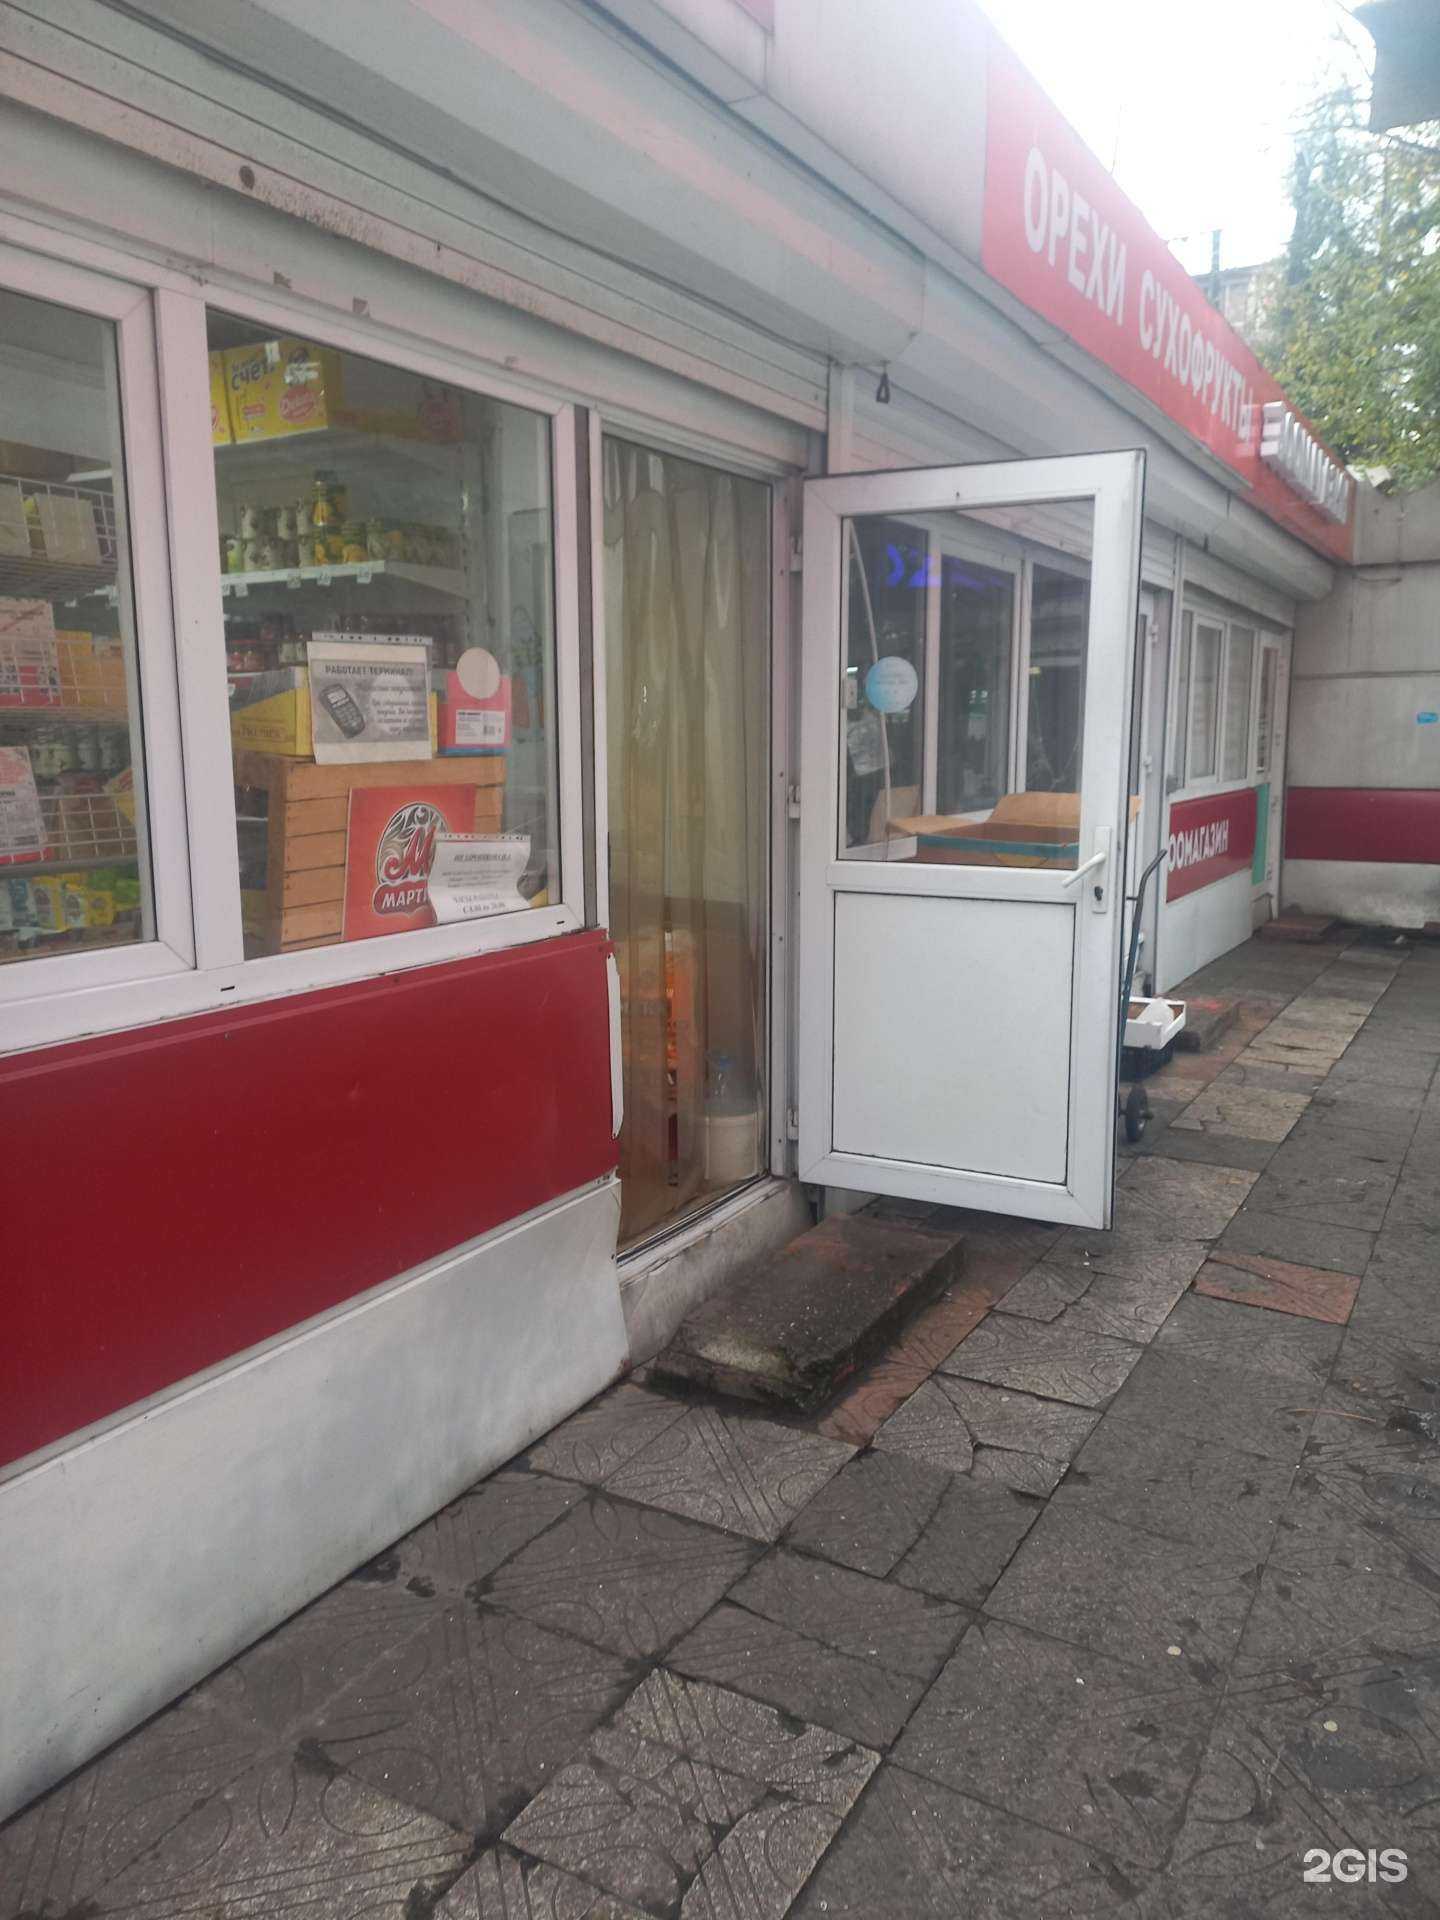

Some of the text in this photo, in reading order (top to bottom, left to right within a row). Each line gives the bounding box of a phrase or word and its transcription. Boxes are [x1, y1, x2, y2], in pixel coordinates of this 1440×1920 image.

[1024, 147, 1254, 443] ОРЕХИ СУХОФРУКТЫ
[1167, 818, 1230, 873] ООМАГАЗИН
